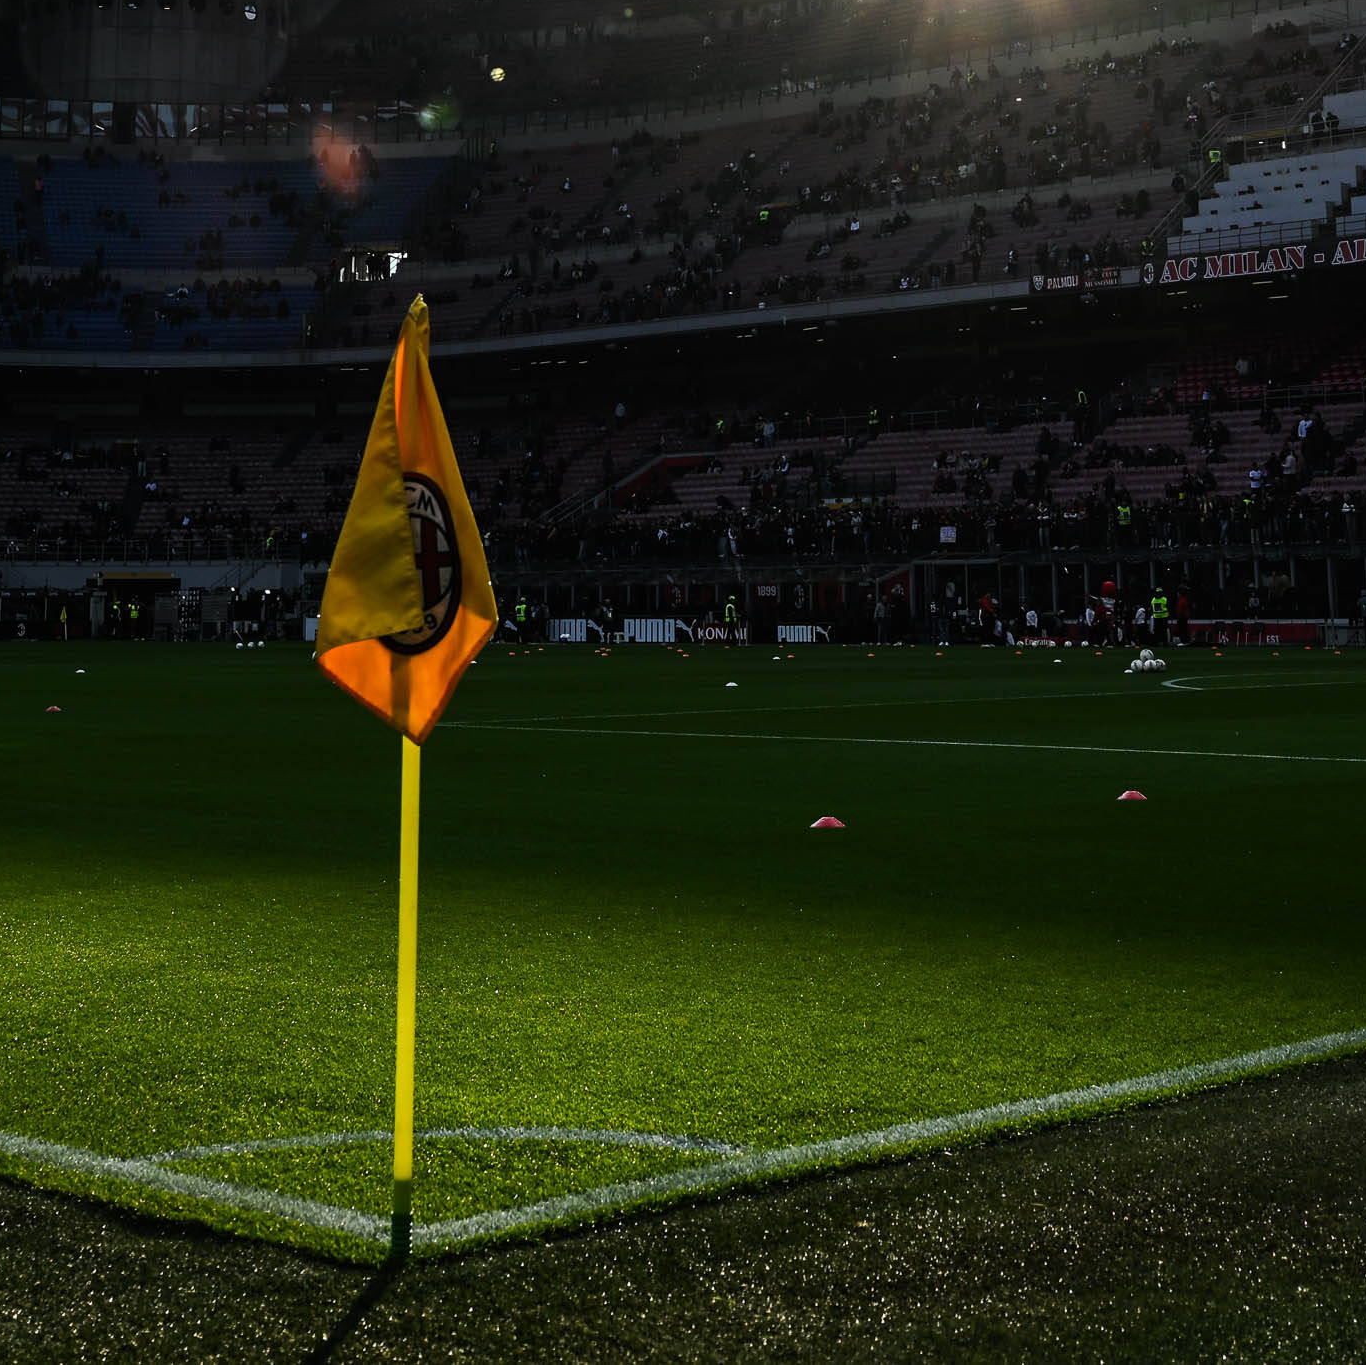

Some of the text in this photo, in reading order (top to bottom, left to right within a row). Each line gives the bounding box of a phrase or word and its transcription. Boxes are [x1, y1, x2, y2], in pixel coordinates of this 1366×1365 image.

[1159, 256, 1198, 284] AC
[1203, 245, 1307, 279] MILAN
[757, 585, 777, 596] 1899
[623, 618, 676, 643] PUMA
